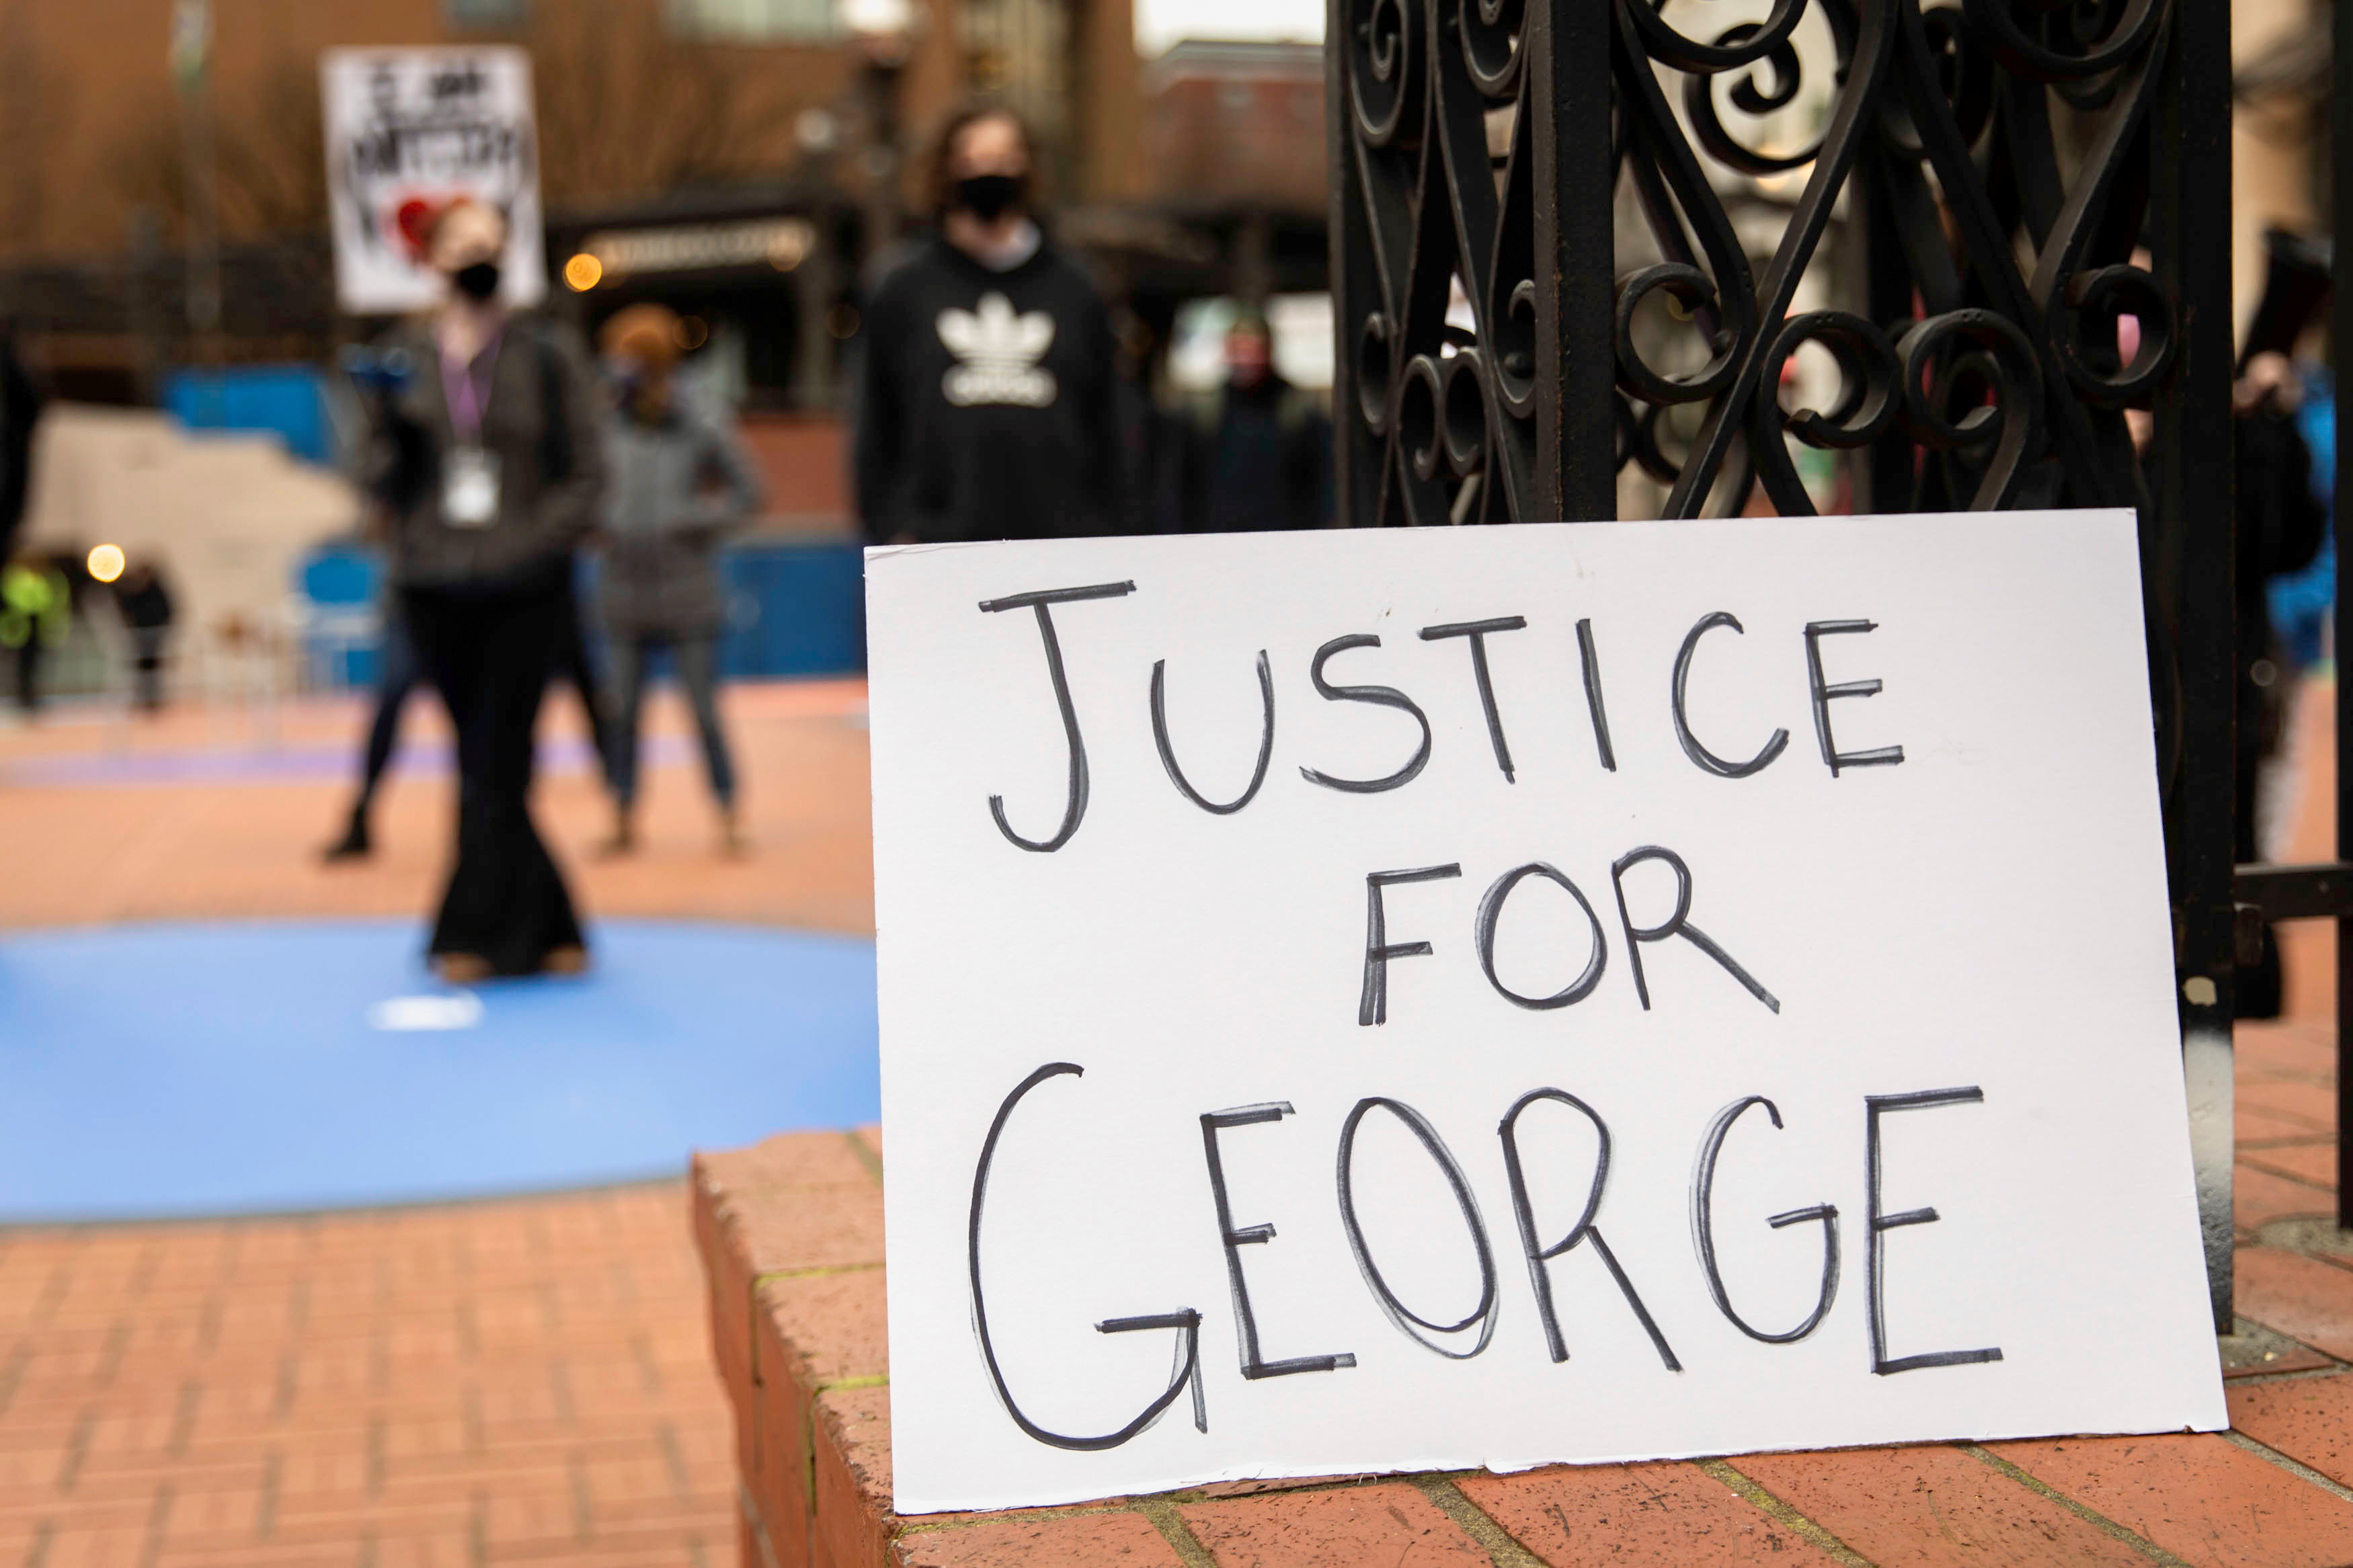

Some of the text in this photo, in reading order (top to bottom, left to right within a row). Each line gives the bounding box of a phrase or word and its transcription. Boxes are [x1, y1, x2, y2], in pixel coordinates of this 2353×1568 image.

[978, 579, 1905, 854] JUSTICE
[1357, 845, 1781, 1028] FOR
[967, 1061, 2005, 1452] GEORGE
